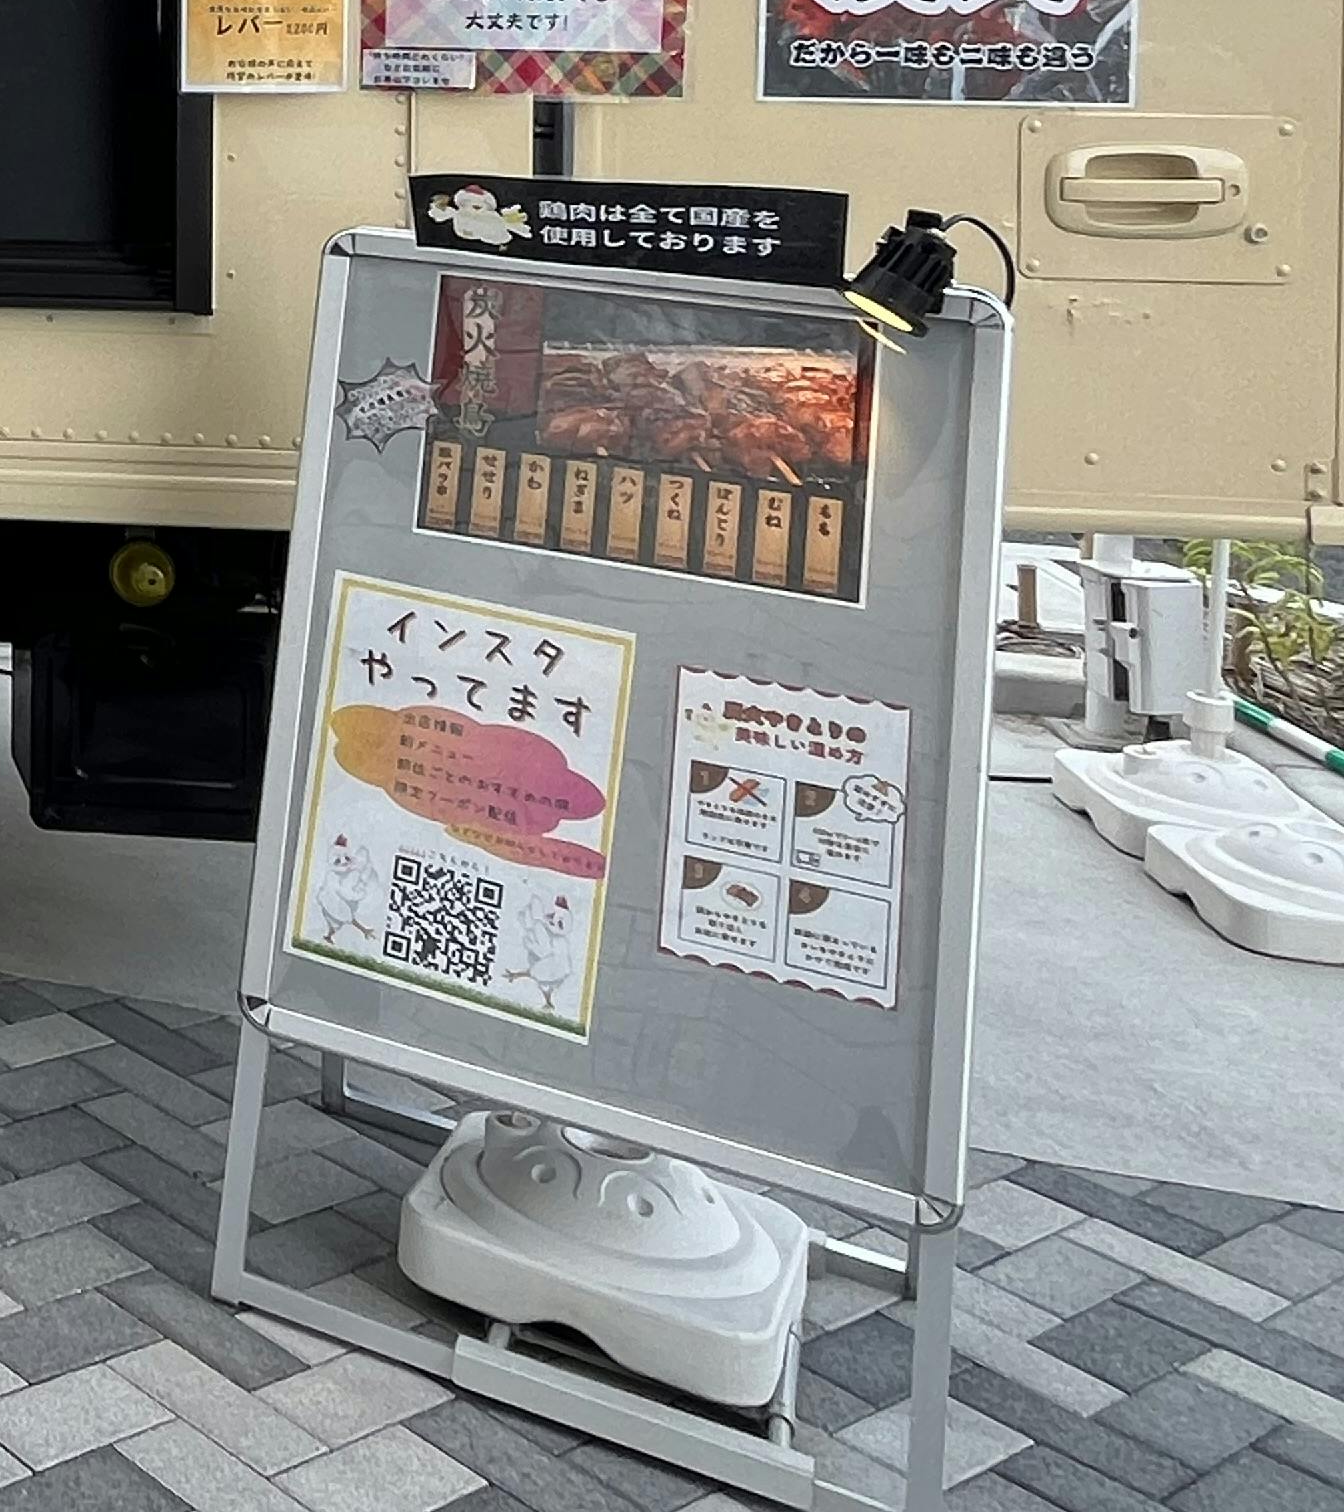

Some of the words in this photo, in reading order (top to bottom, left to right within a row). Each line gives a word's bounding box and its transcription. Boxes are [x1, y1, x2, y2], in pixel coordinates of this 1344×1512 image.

[216, 14, 283, 35] レバー
[791, 40, 1096, 70] だから一味も二味も違う
[538, 199, 780, 230] 鶏肉は全て国産を
[540, 224, 781, 256] 使用しております
[667, 479, 684, 521] つくね
[765, 496, 783, 529] むね
[818, 504, 831, 536] もも
[387, 610, 566, 676] インスタ
[361, 649, 591, 738] やってます
